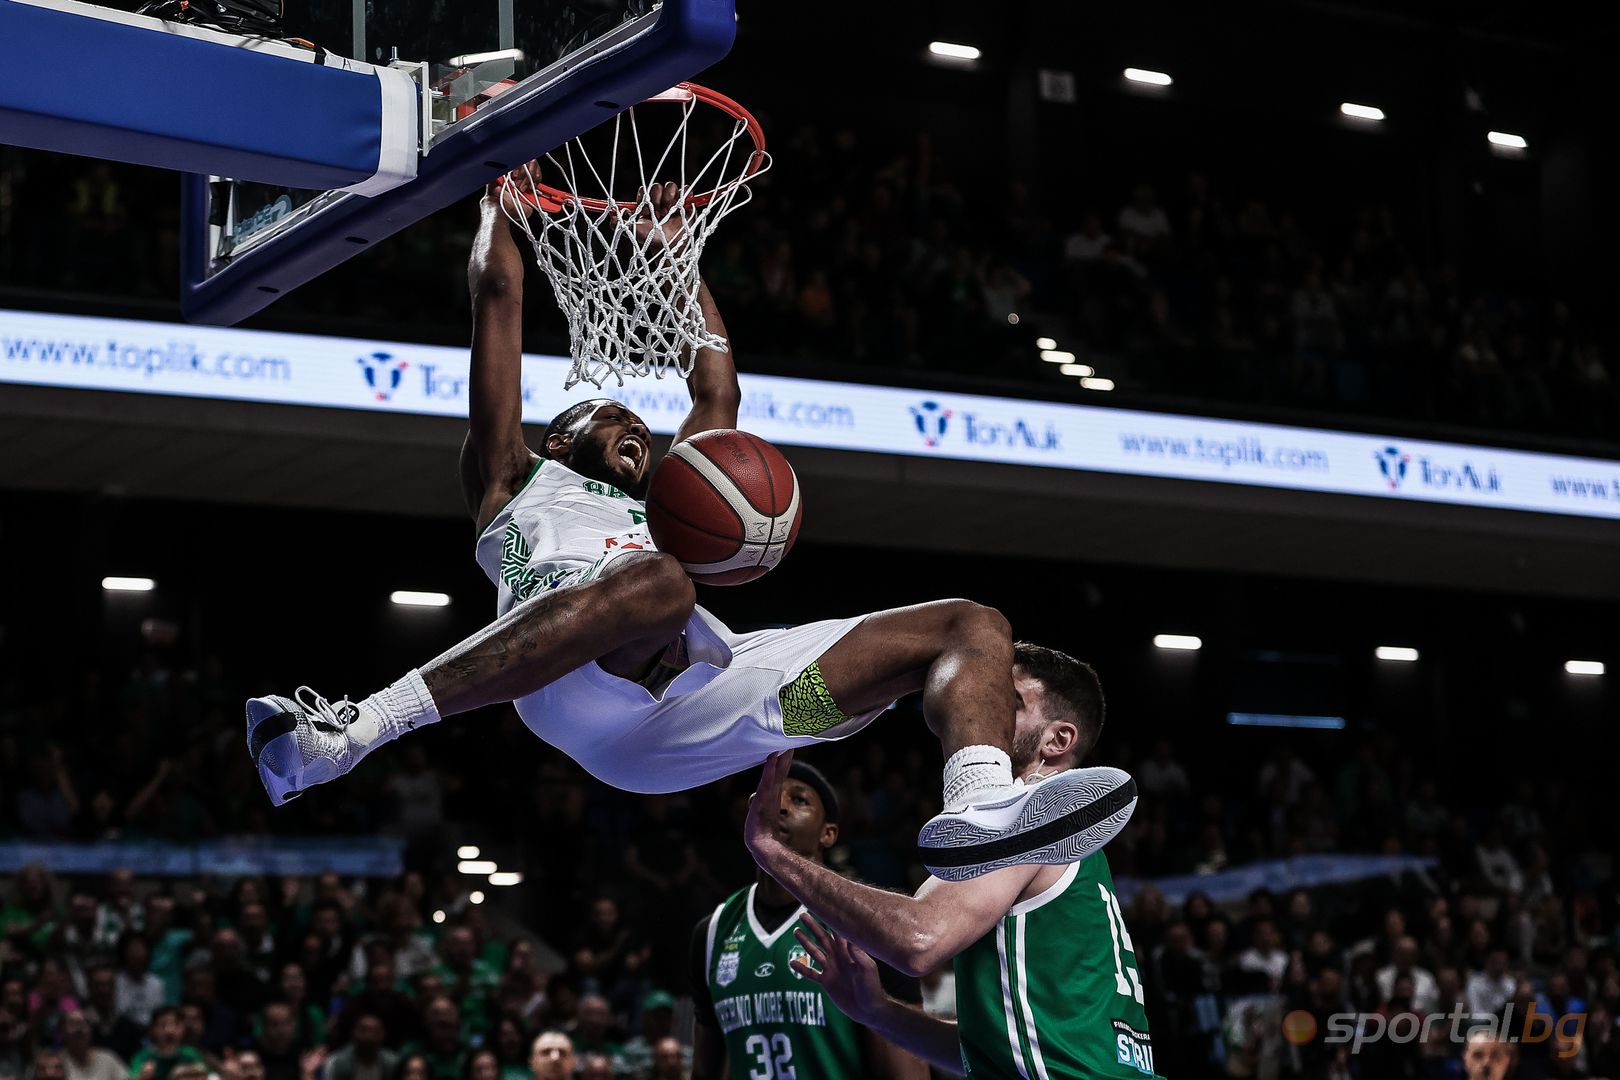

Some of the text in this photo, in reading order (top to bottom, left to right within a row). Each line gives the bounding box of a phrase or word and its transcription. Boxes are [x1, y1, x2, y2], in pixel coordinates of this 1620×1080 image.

[1, 338, 292, 381] www.toplik.com
[1119, 433, 1330, 473] www.toplik.com
[754, 991, 785, 1024] MORE
[785, 991, 826, 1026] TICHA
[745, 1033, 797, 1080] 32
